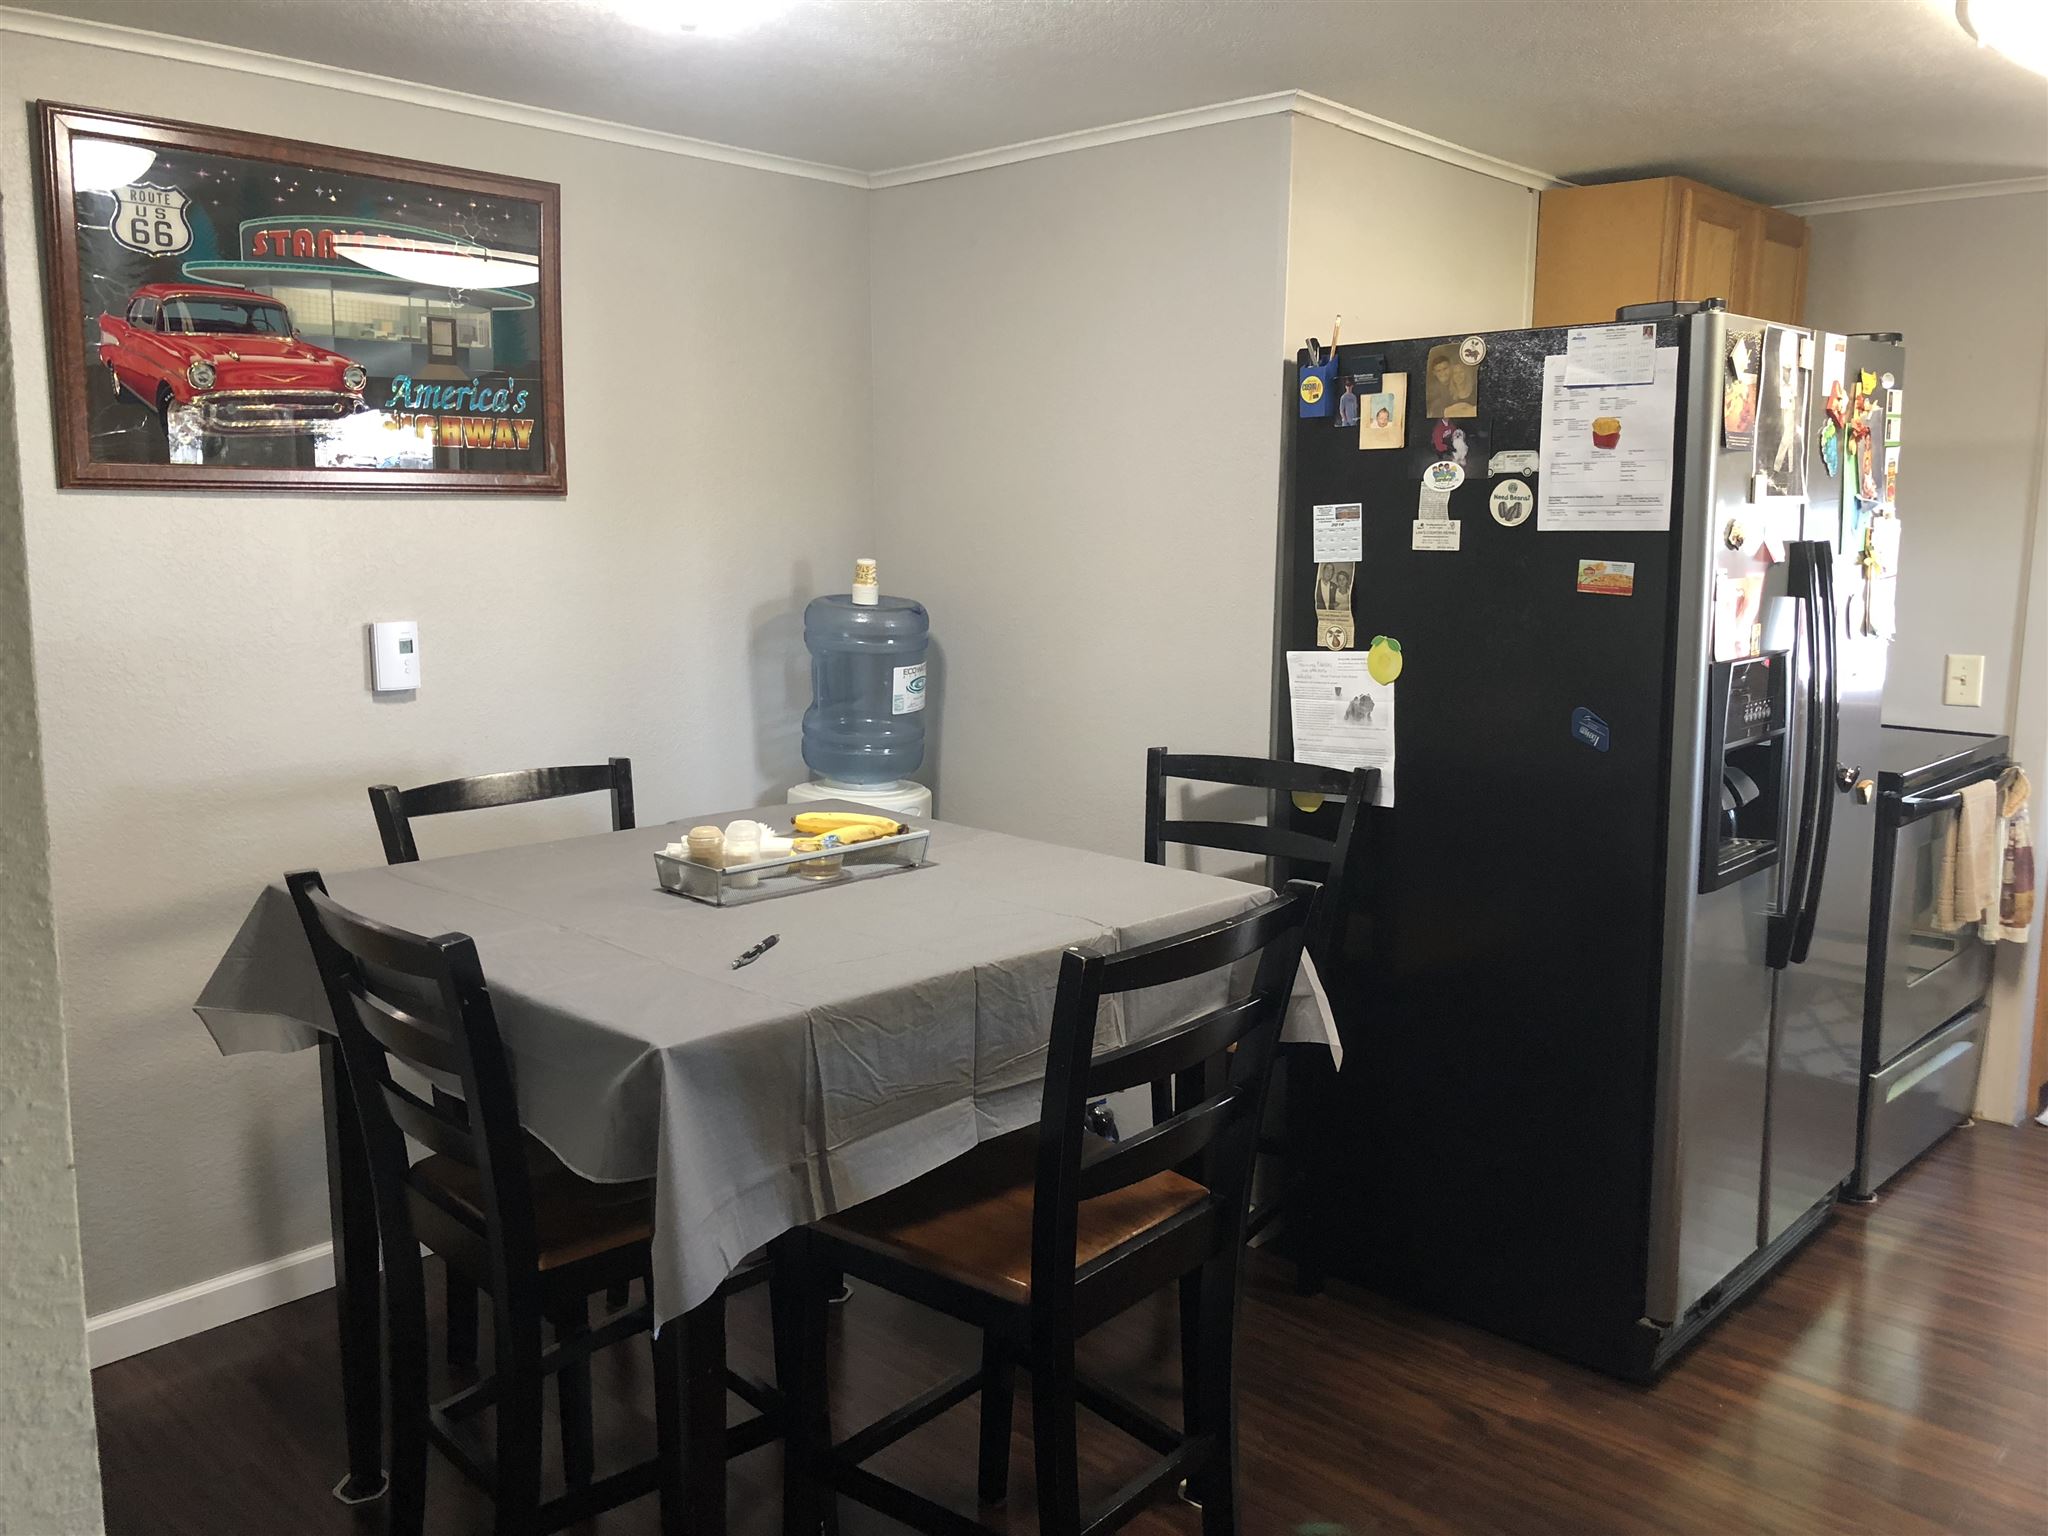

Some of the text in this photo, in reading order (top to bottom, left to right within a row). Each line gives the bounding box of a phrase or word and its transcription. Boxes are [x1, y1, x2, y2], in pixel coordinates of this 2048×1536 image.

[129, 188, 171, 206] ROUTE
[130, 218, 173, 247] 66
[385, 374, 529, 414] America's
